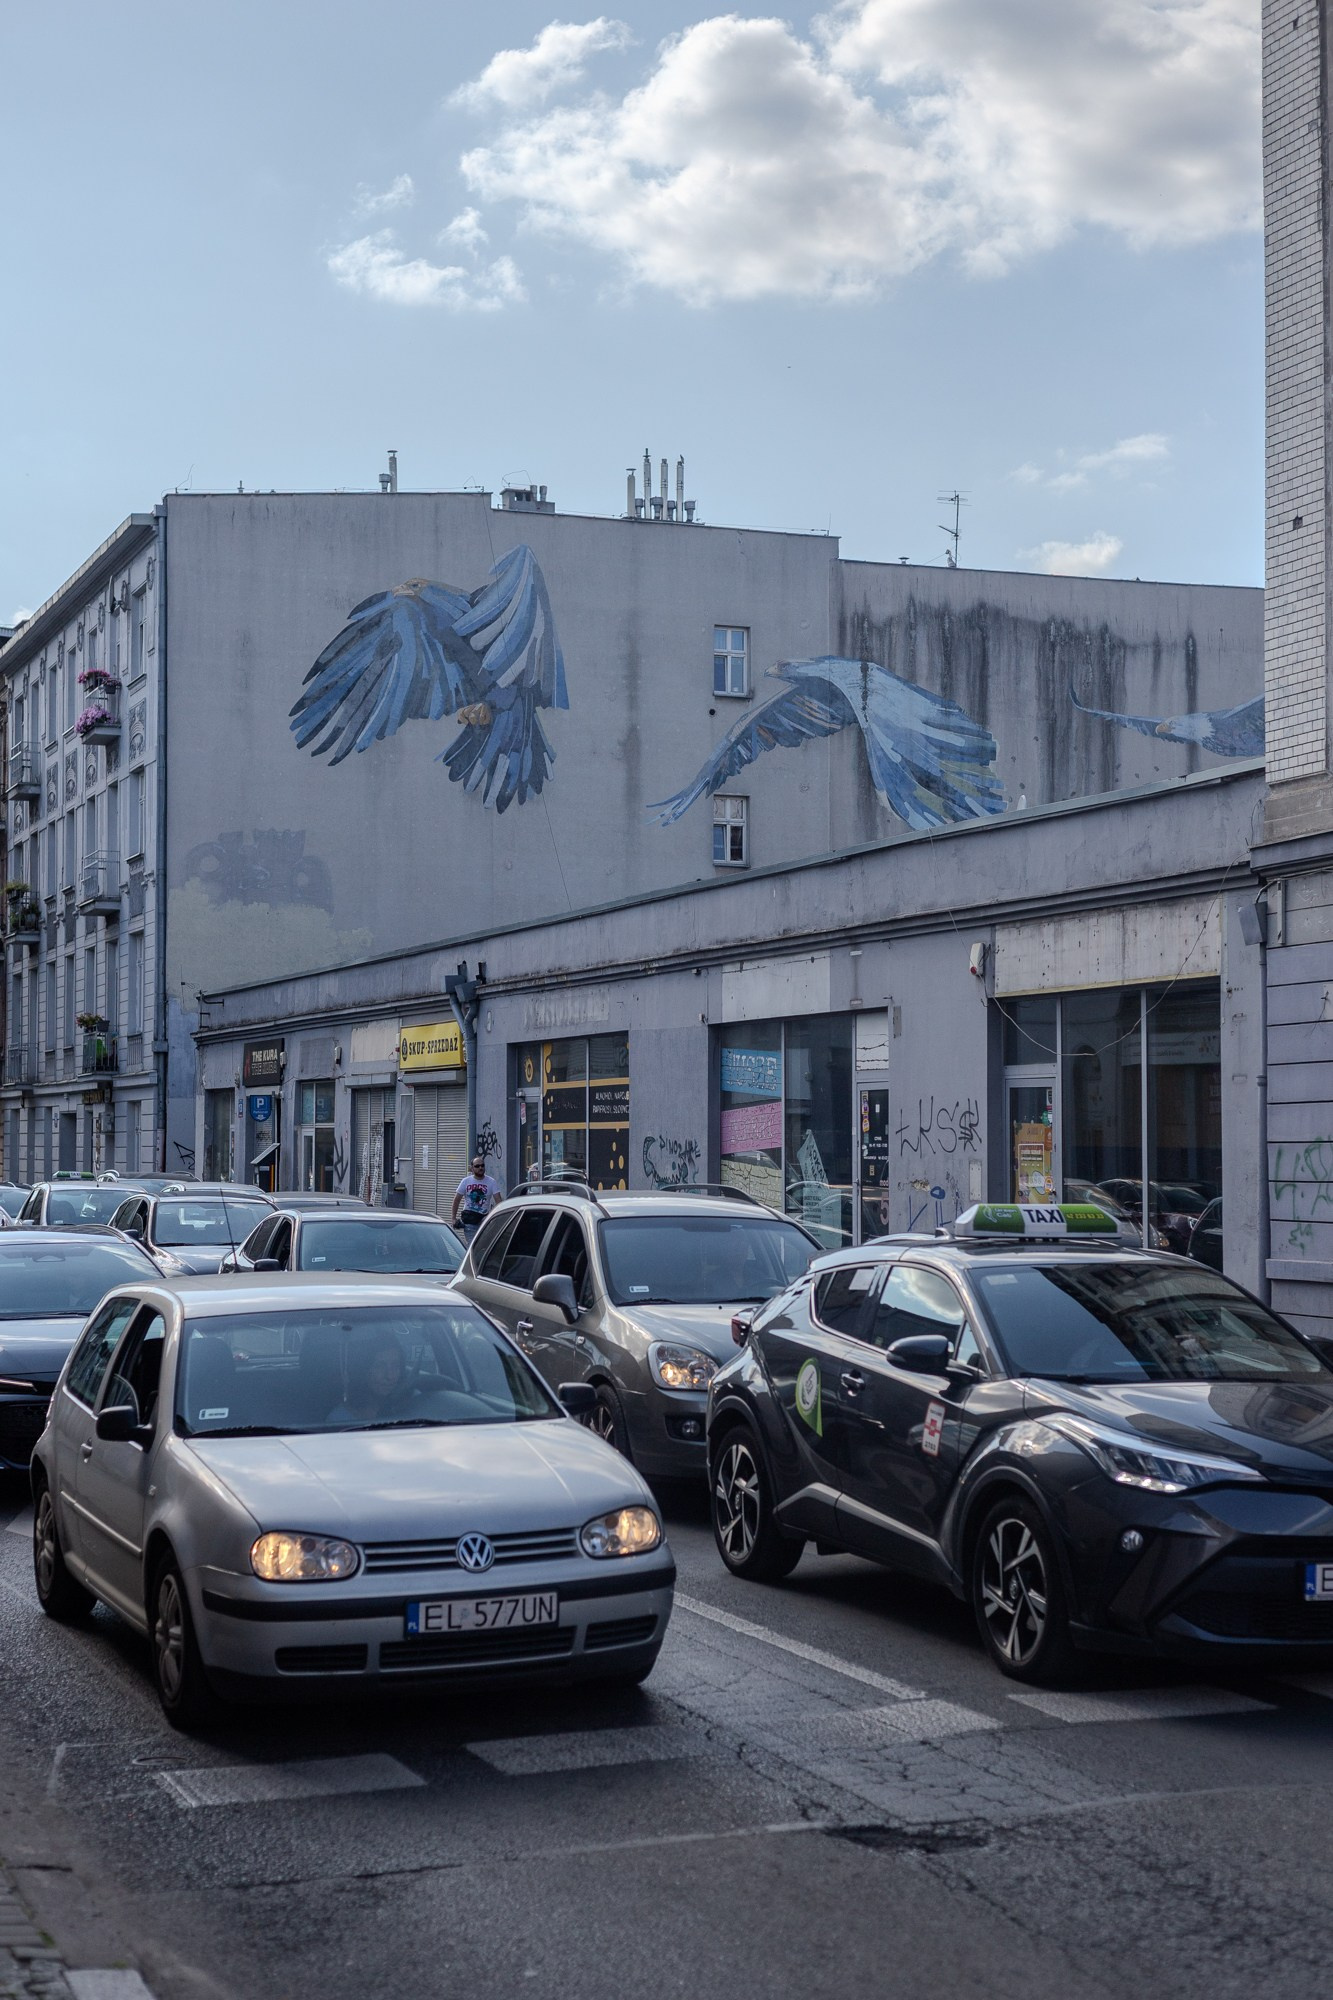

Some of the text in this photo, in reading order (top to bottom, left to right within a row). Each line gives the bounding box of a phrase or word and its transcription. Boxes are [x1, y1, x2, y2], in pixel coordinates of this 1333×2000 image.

[257, 1098, 264, 1108] P
[1023, 1208, 1065, 1224] TAXI
[407, 1595, 554, 1631] PL EL 577UN
